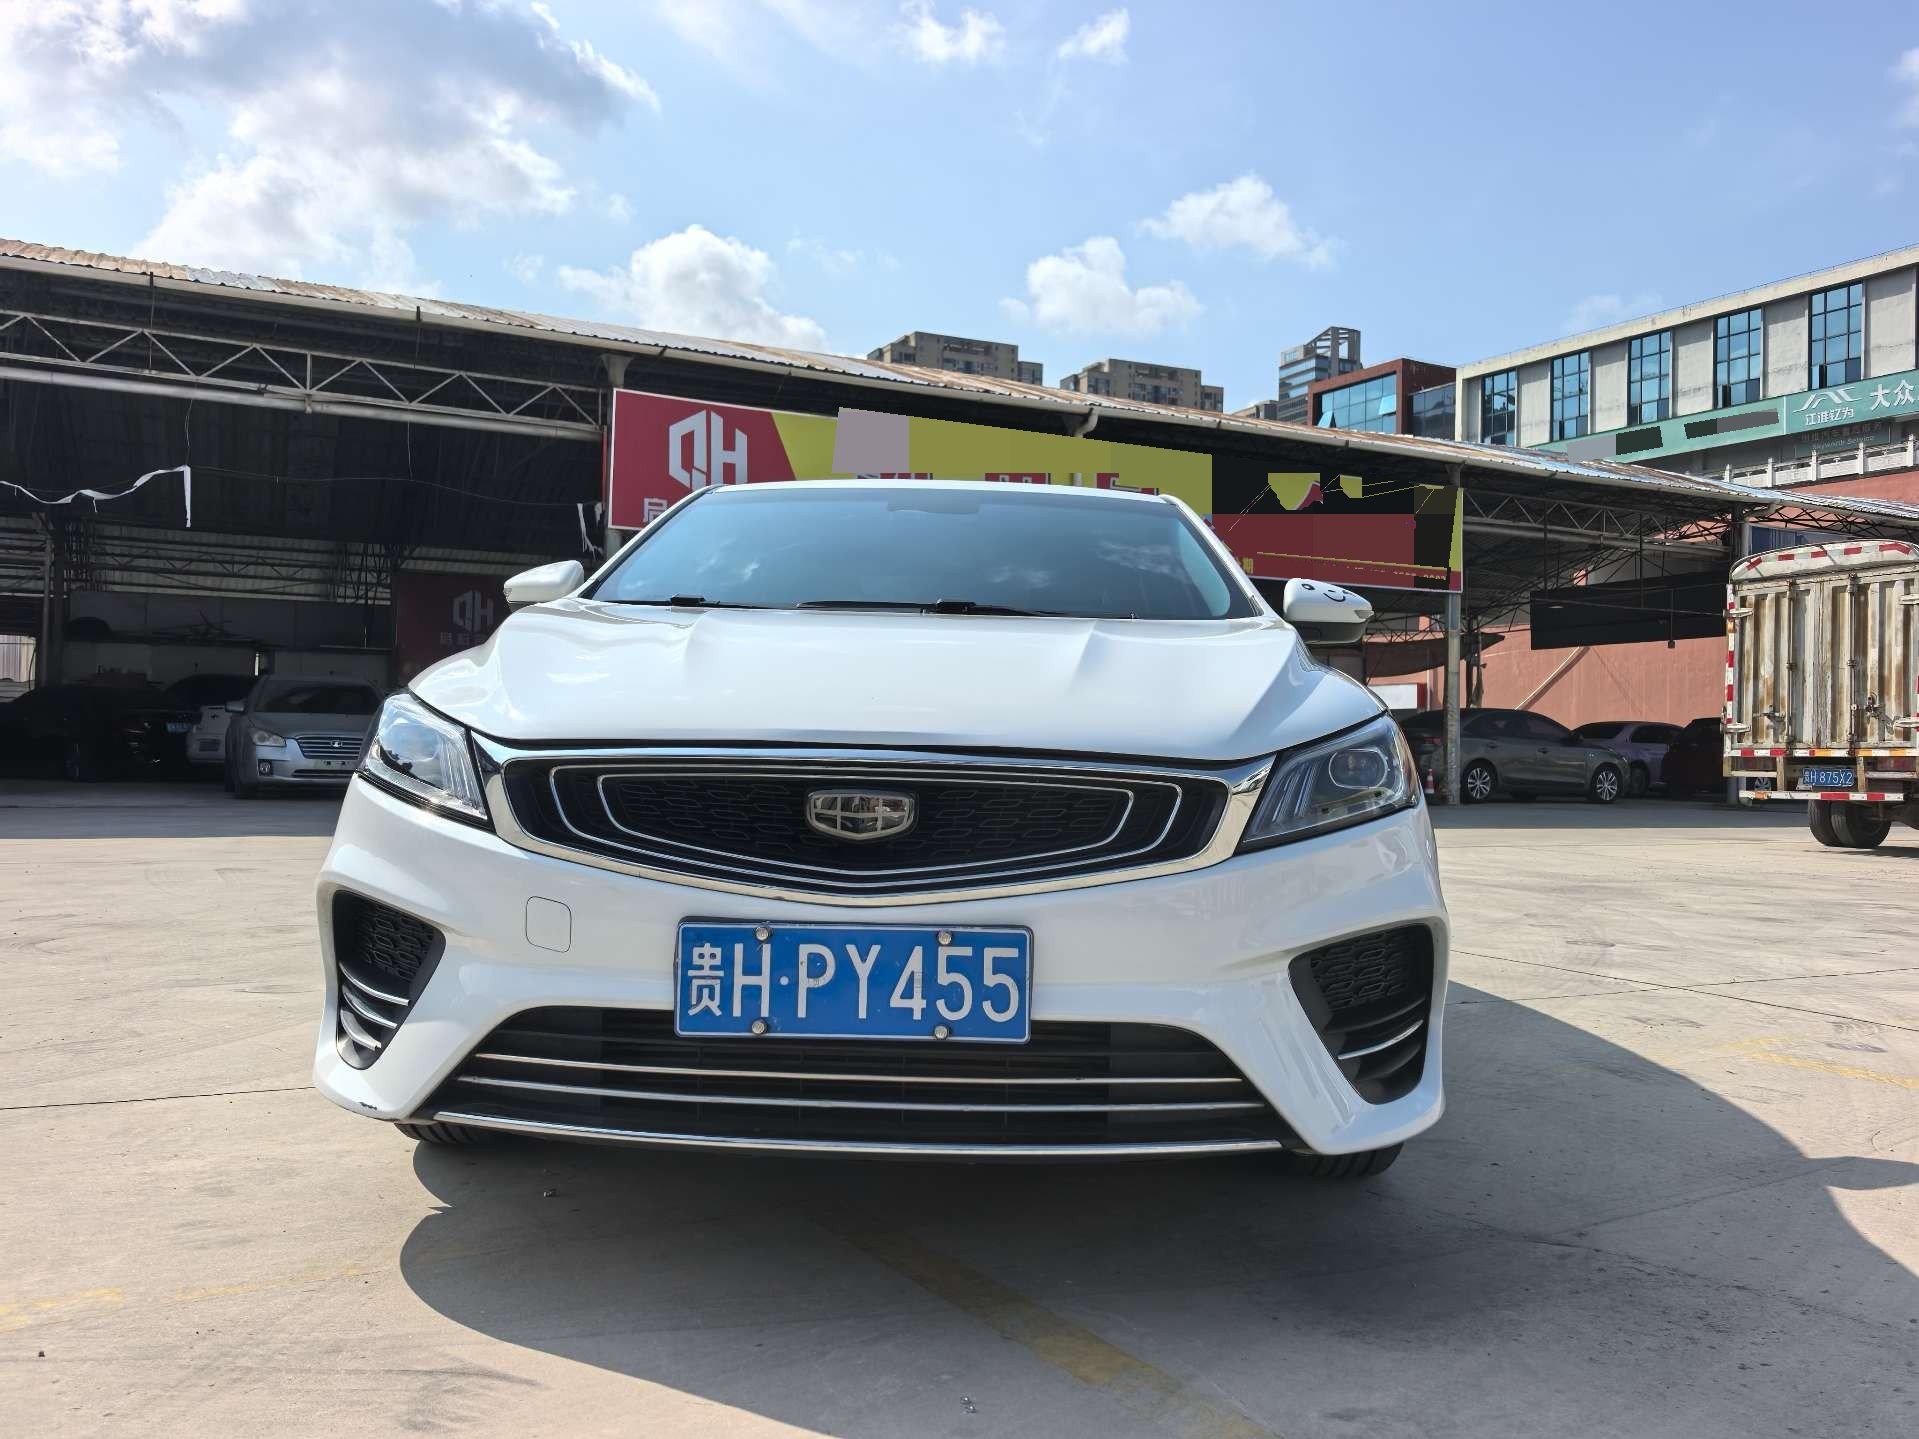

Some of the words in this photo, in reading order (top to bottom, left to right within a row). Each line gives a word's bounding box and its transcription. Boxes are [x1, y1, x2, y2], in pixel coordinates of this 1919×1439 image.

[1870, 379, 1919, 411] 大众
[1805, 406, 1855, 426] 江淮钇为
